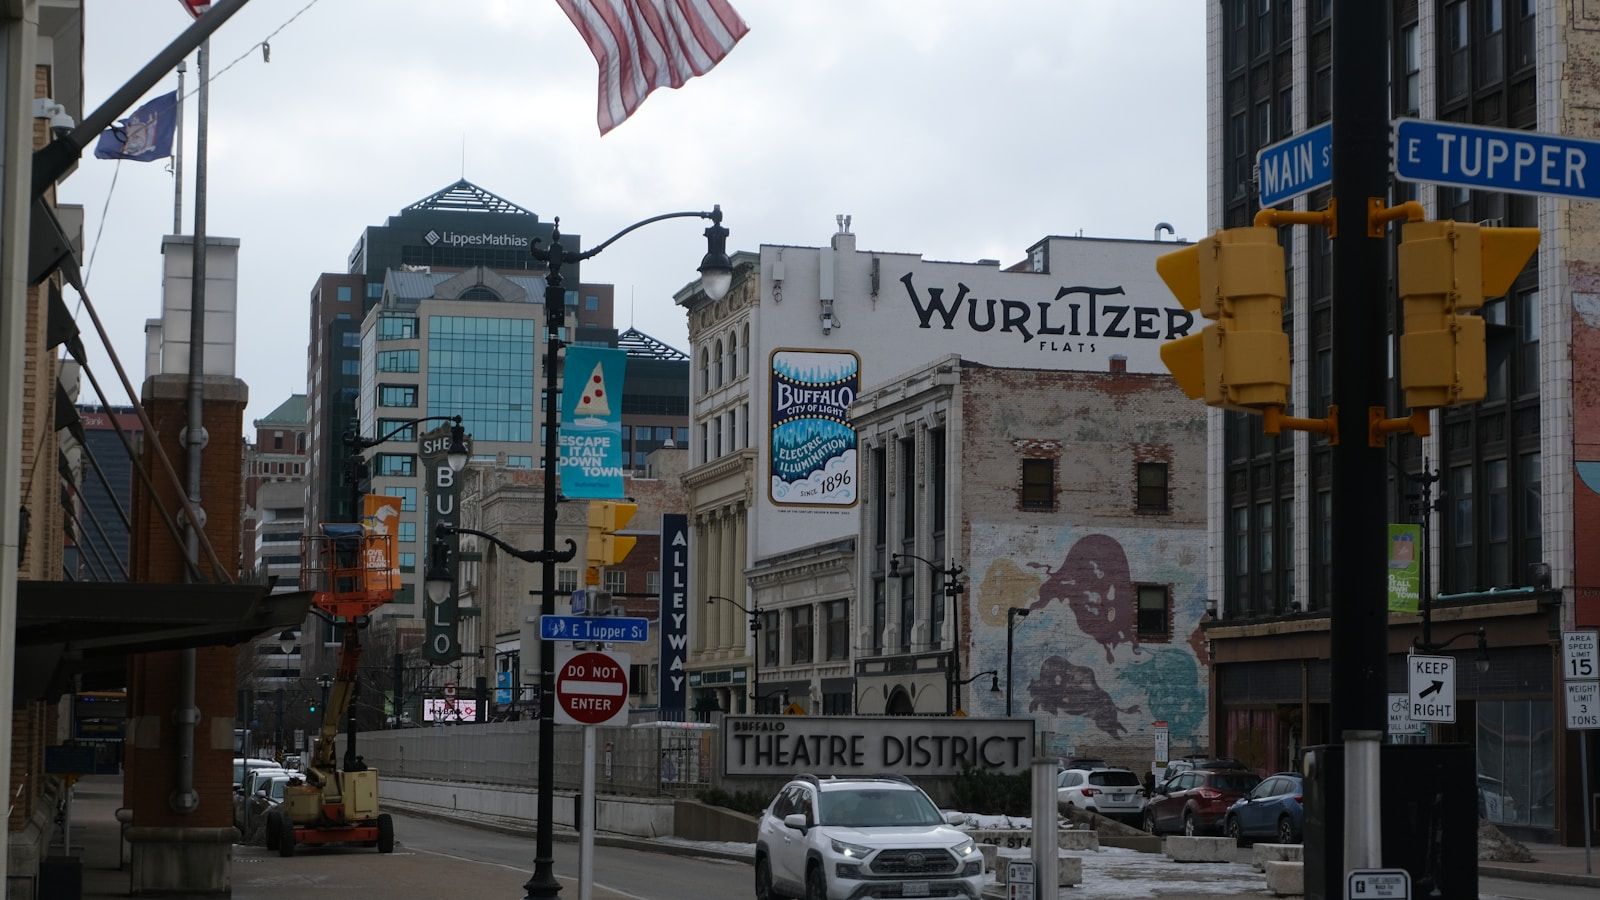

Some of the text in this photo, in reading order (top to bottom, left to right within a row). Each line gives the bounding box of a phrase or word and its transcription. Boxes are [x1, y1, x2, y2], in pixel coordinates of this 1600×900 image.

[1407, 133, 1587, 189] E TUPPER
[1264, 140, 1333, 198] MAIN S
[443, 231, 528, 247] LippesMathias
[899, 272, 1194, 342] WURLITZER
[1040, 341, 1096, 353] FLATS
[778, 382, 853, 411] BUFFALO
[787, 404, 844, 418] CITY OF LIGHT
[560, 435, 611, 448] ESCAPE
[779, 436, 823, 461] ELECTRIC
[560, 456, 602, 467] DOWN
[780, 438, 847, 473] ILLUMINATION
[582, 466, 624, 478] TOWN
[800, 469, 851, 498] SINCE 1896
[434, 467, 454, 654] BULO
[668, 530, 688, 692] ALLEYWAY
[572, 624, 579, 636] E
[584, 620, 626, 639] Tupper
[568, 666, 618, 678] DO NOT
[1416, 661, 1448, 674] KEEP
[1571, 659, 1592, 676] 15
[1568, 685, 1597, 694] WEIGHT
[571, 698, 611, 711] ENTER
[1573, 694, 1592, 703] LIMIT
[1414, 703, 1452, 717] RIGHT
[1580, 704, 1587, 713] 3
[734, 721, 785, 732] BUFFALO
[1571, 715, 1597, 725] TONS
[734, 734, 865, 768] THEATRE
[883, 736, 1026, 769] DISTRICT
